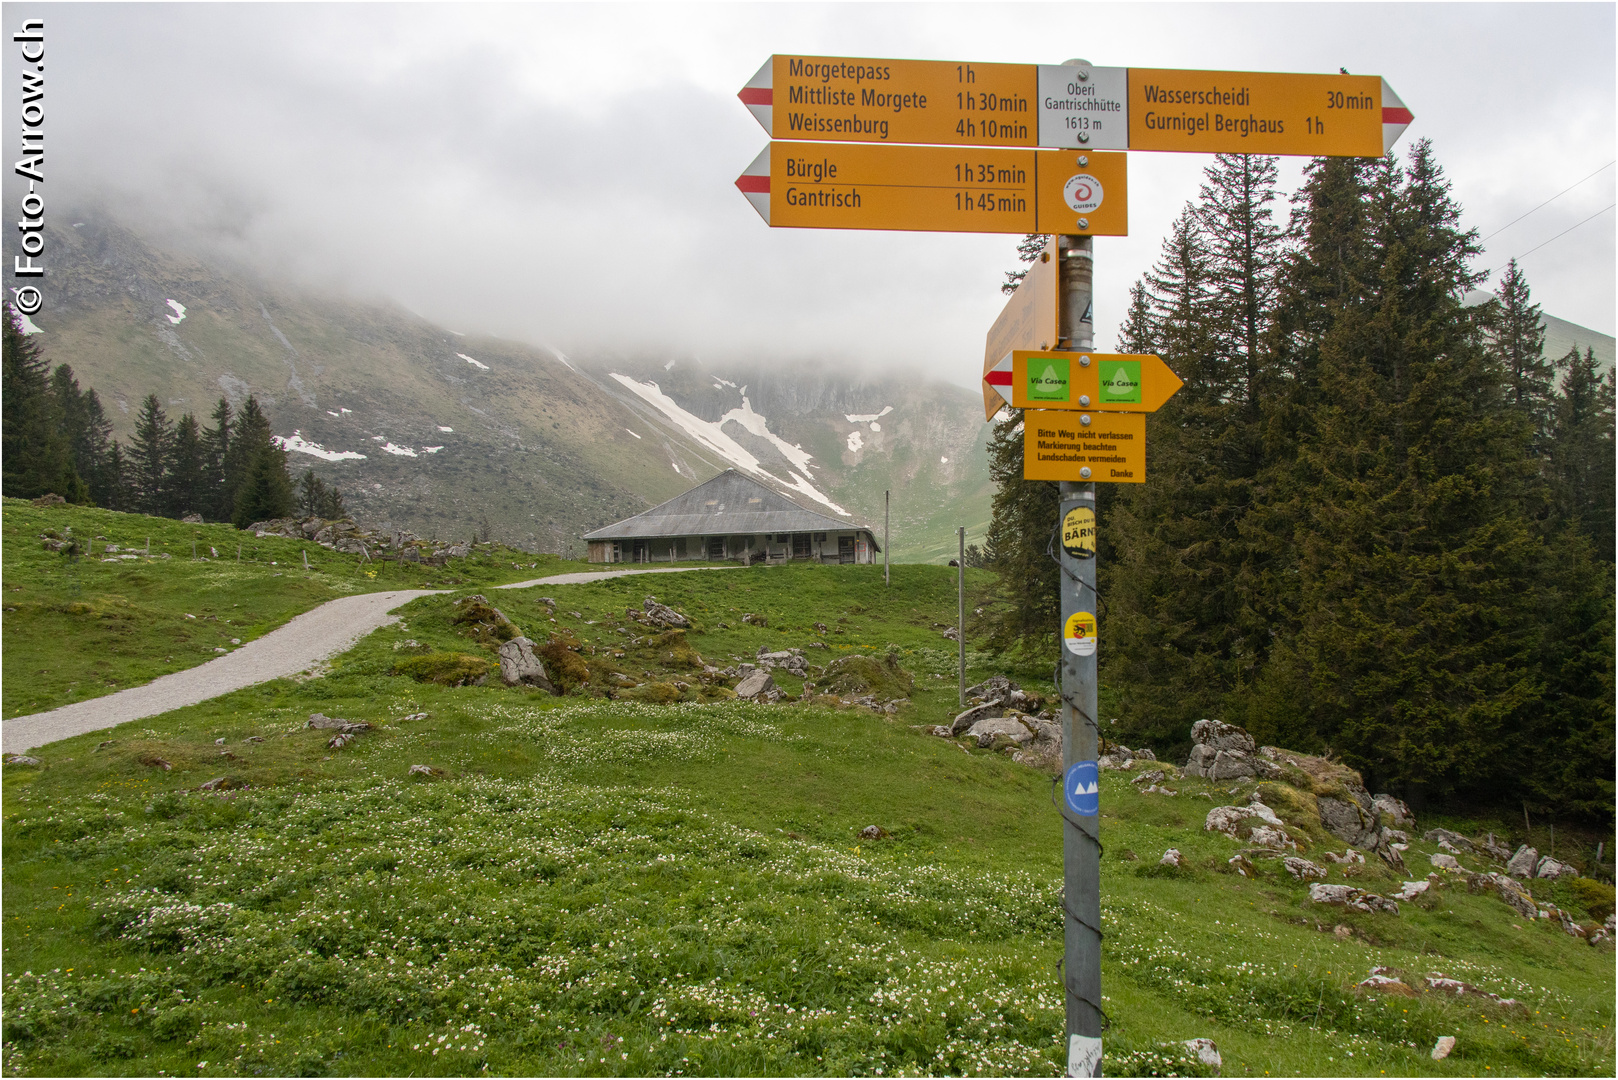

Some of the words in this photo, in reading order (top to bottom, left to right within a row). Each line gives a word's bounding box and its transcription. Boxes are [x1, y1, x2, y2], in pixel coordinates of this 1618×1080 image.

[789, 59, 890, 84] Morgetepass
[1067, 83, 1095, 96] Oberi
[1144, 85, 1250, 106] Wasserscheidi
[789, 86, 855, 106] Mittliste
[861, 88, 927, 113] Morgete
[1045, 97, 1121, 112] Gantrischhütte
[788, 112, 889, 139] Weissenburg
[1065, 116, 1089, 130] 1613
[1093, 120, 1102, 130] m
[1145, 112, 1209, 136] Gurnigel
[1215, 114, 1285, 138] Berghaus
[787, 158, 837, 183] Bürgle
[786, 187, 862, 208] Gantrisch
[1037, 429, 1056, 438] Bitte
[1058, 430, 1075, 440] Weg
[1078, 430, 1096, 439] nicht
[1098, 432, 1133, 440] verlassen
[1038, 441, 1081, 452] Markierung
[1083, 442, 1117, 451] beachten
[1038, 452, 1086, 462] Landschaden
[1088, 454, 1126, 463] vermeiden
[1110, 469, 1133, 478] Danke
[1065, 527, 1095, 541] BÄRN
